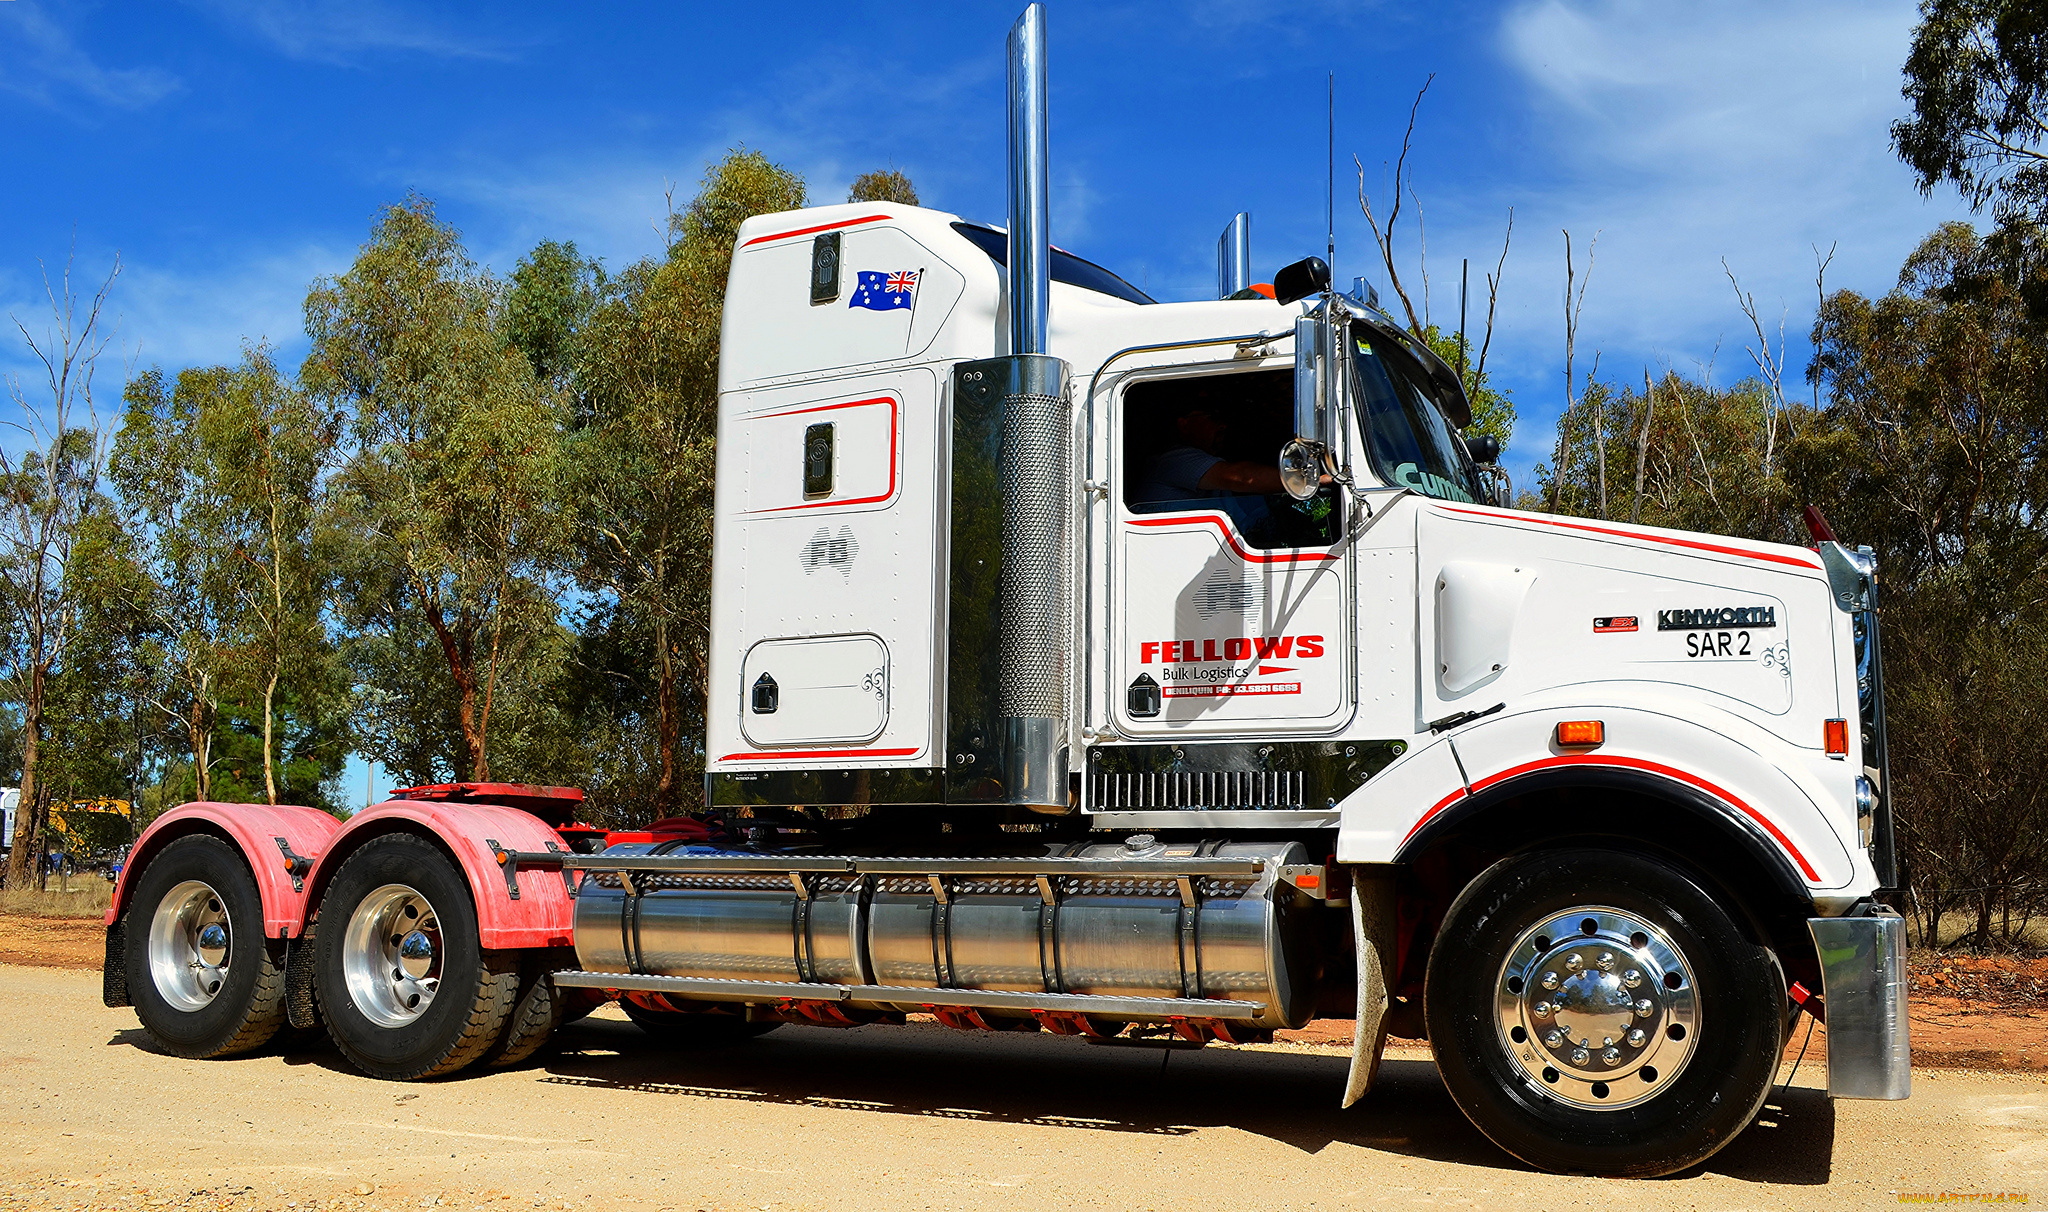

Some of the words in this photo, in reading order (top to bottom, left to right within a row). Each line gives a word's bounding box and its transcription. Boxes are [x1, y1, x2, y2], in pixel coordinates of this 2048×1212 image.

[1657, 606, 1775, 627] KENWORTH
[1141, 635, 1324, 664] FELLOWS
[1686, 632, 1733, 658] SAR
[1737, 631, 1751, 656] 2
[1163, 668, 1189, 681] Bulk
[1193, 666, 1249, 683] Logistics
[1165, 686, 1213, 696] DENILIQUIN
